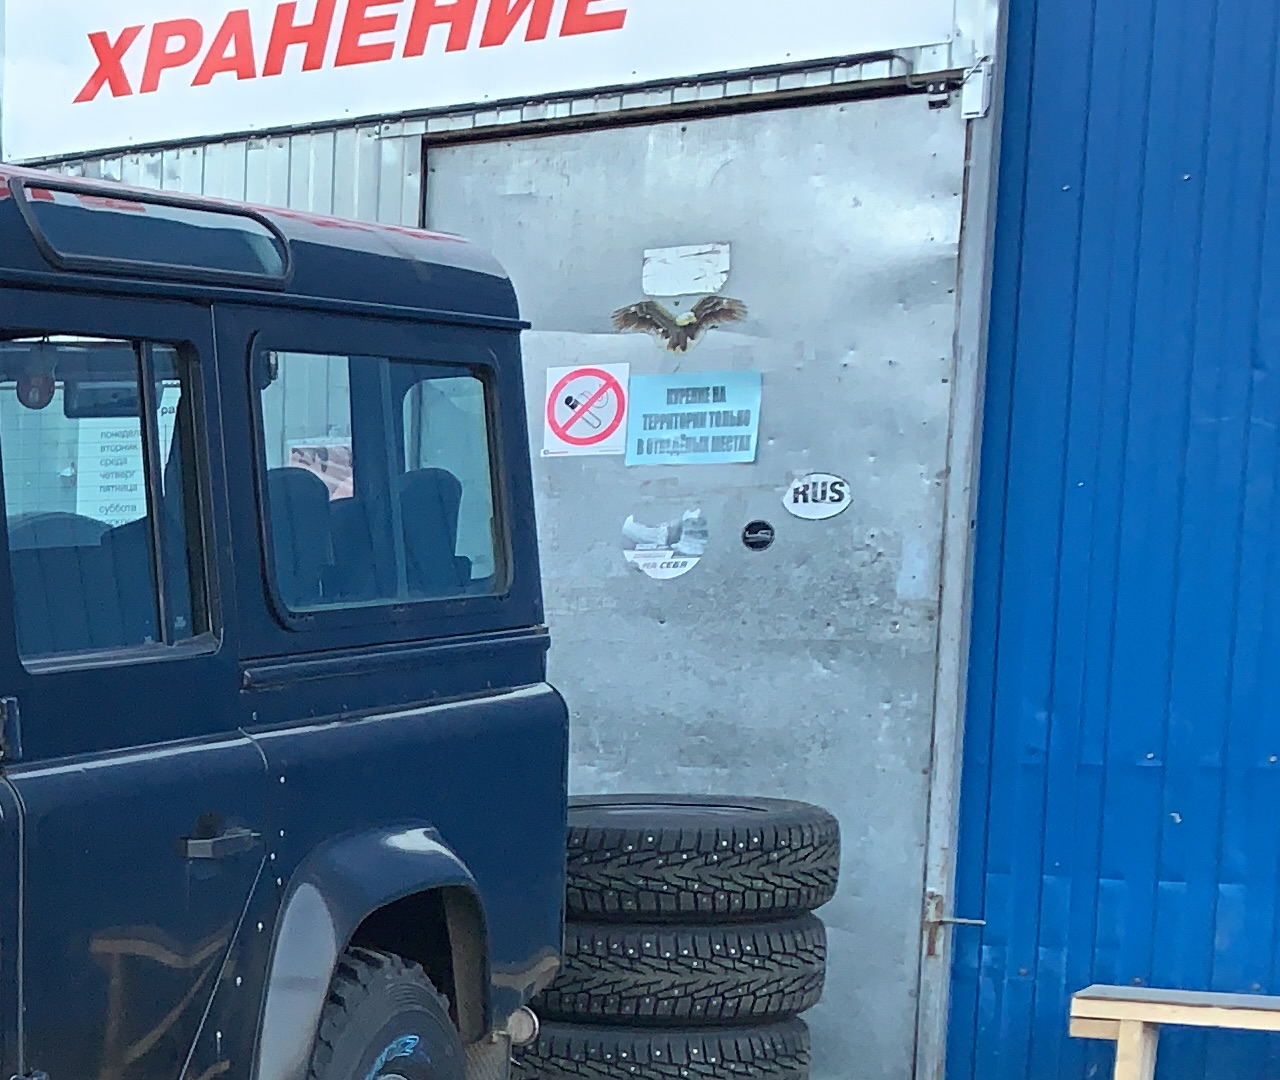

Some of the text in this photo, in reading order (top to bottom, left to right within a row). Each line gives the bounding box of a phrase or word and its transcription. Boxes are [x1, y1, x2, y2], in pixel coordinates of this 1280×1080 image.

[72, 0, 628, 104] ХРАНЕНИЕ
[709, 409, 751, 428] ТОЛЬКО
[636, 438, 644, 455] В
[792, 481, 845, 504] RUS
[98, 504, 137, 515] суббота
